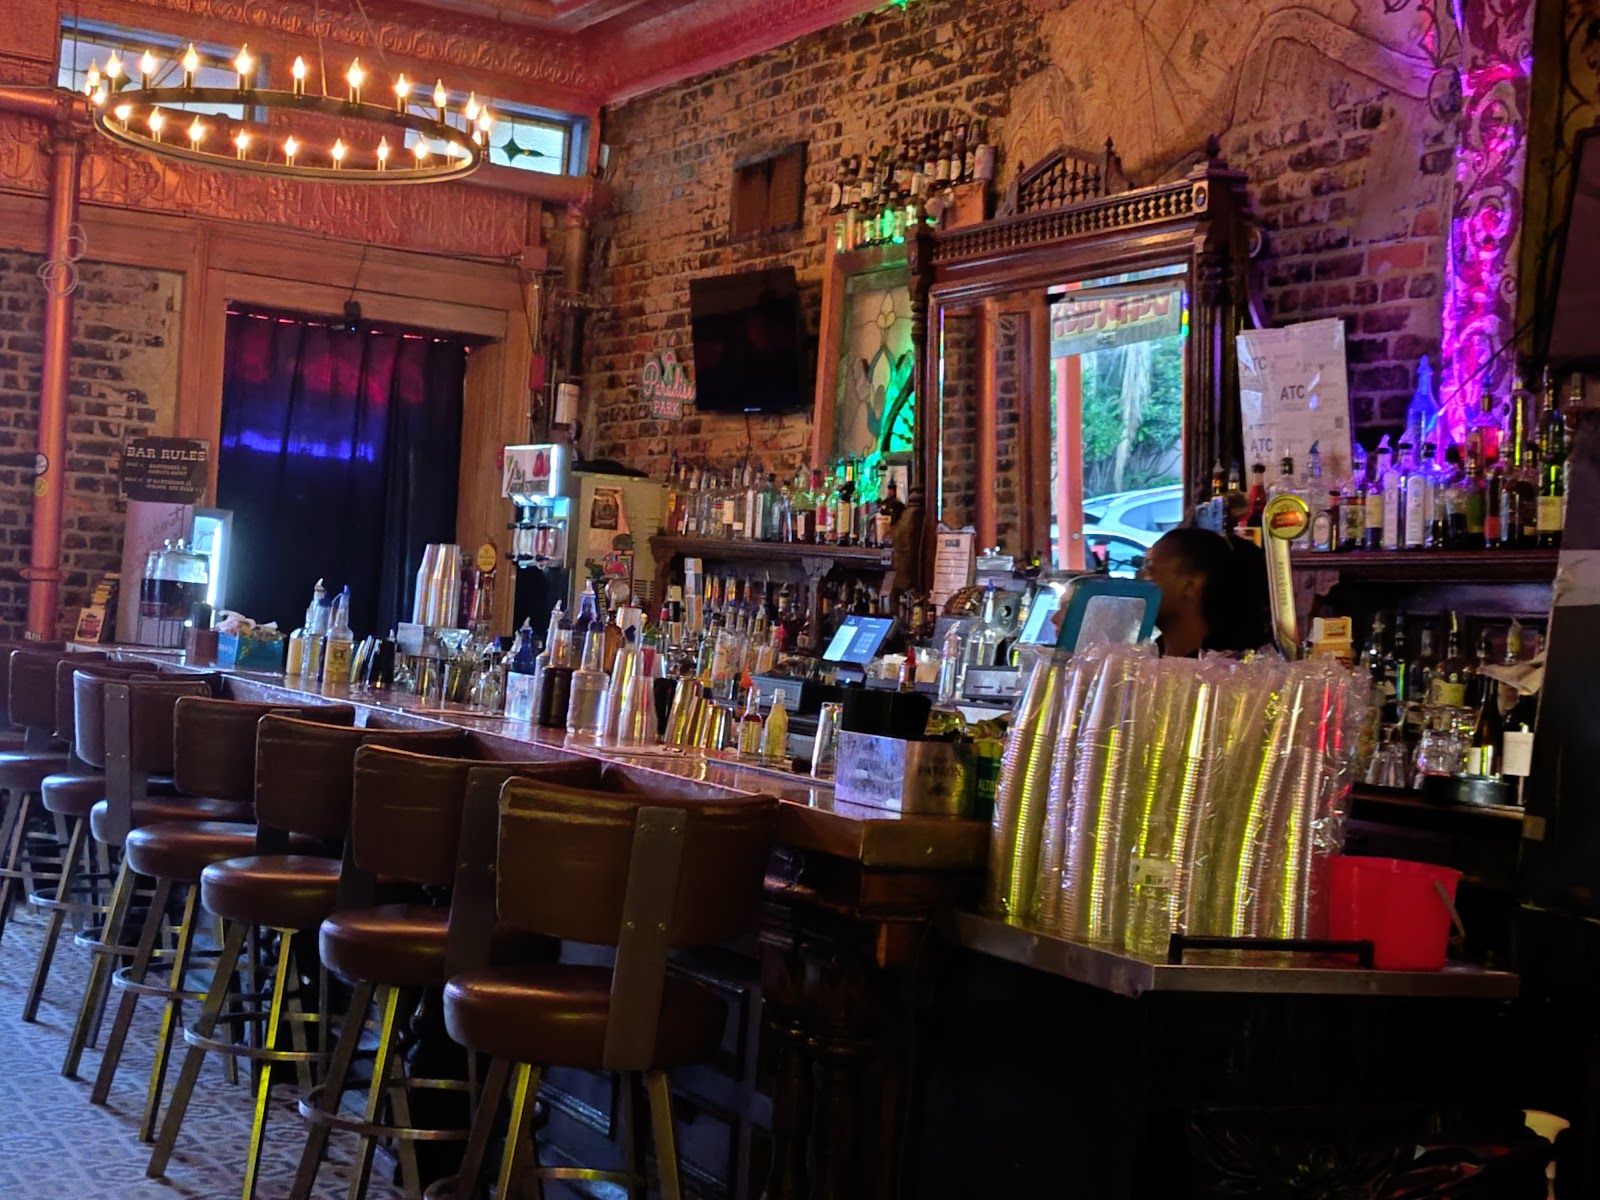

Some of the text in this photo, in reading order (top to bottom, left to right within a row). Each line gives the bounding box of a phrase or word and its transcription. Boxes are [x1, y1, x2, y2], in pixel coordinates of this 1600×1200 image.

[1280, 385, 1305, 401] ATC
[654, 400, 680, 416] PARK
[1250, 438, 1273, 453] ATC
[127, 447, 206, 461] BAR RULES
